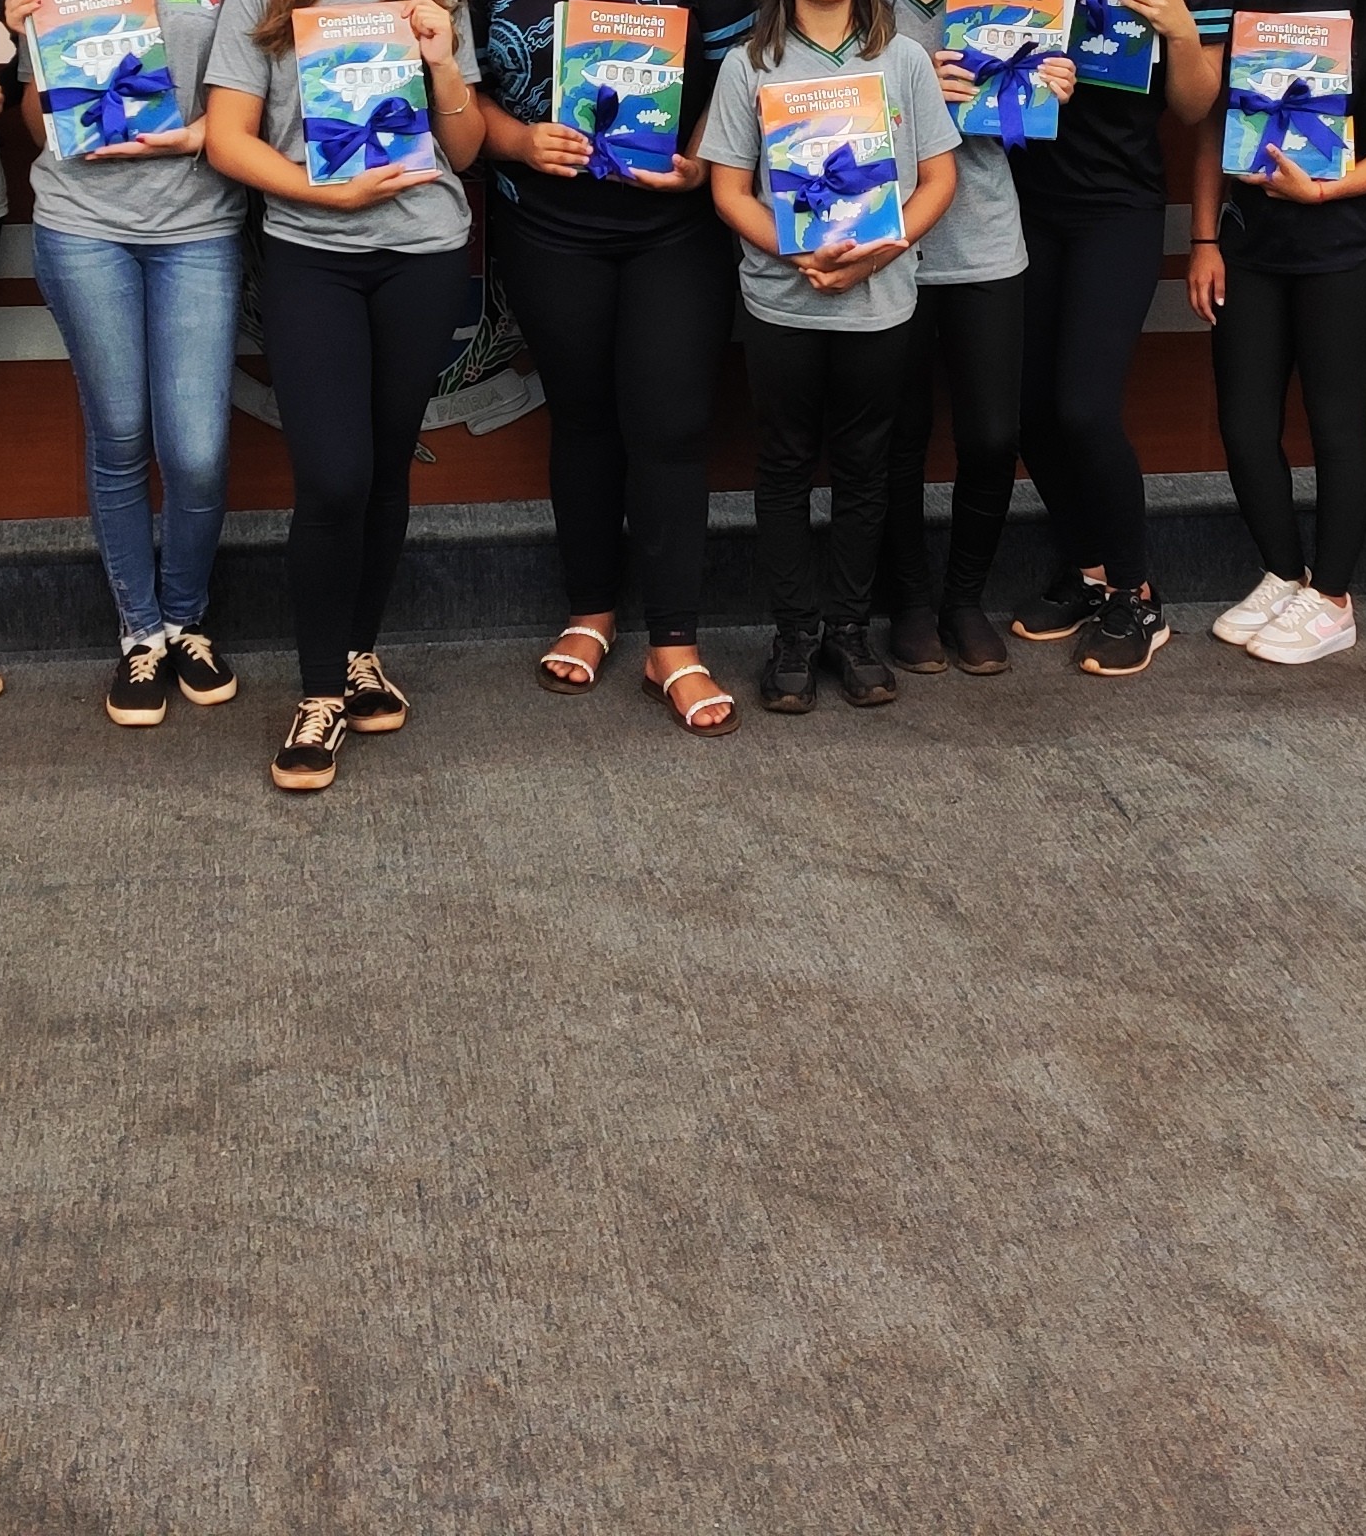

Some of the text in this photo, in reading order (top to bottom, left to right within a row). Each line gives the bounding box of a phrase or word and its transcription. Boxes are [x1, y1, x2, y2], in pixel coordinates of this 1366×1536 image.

[59, 4, 79, 15] em
[318, 12, 394, 28] Constituição
[591, 11, 665, 27] Constituição
[323, 24, 395, 39] em Miúdos II
[592, 24, 664, 38] em Miúdos II
[1256, 21, 1329, 37] Constituição
[1258, 33, 1328, 47] em Miúdos II
[785, 86, 859, 104] Constituição
[788, 96, 860, 114] em Miúdos II
